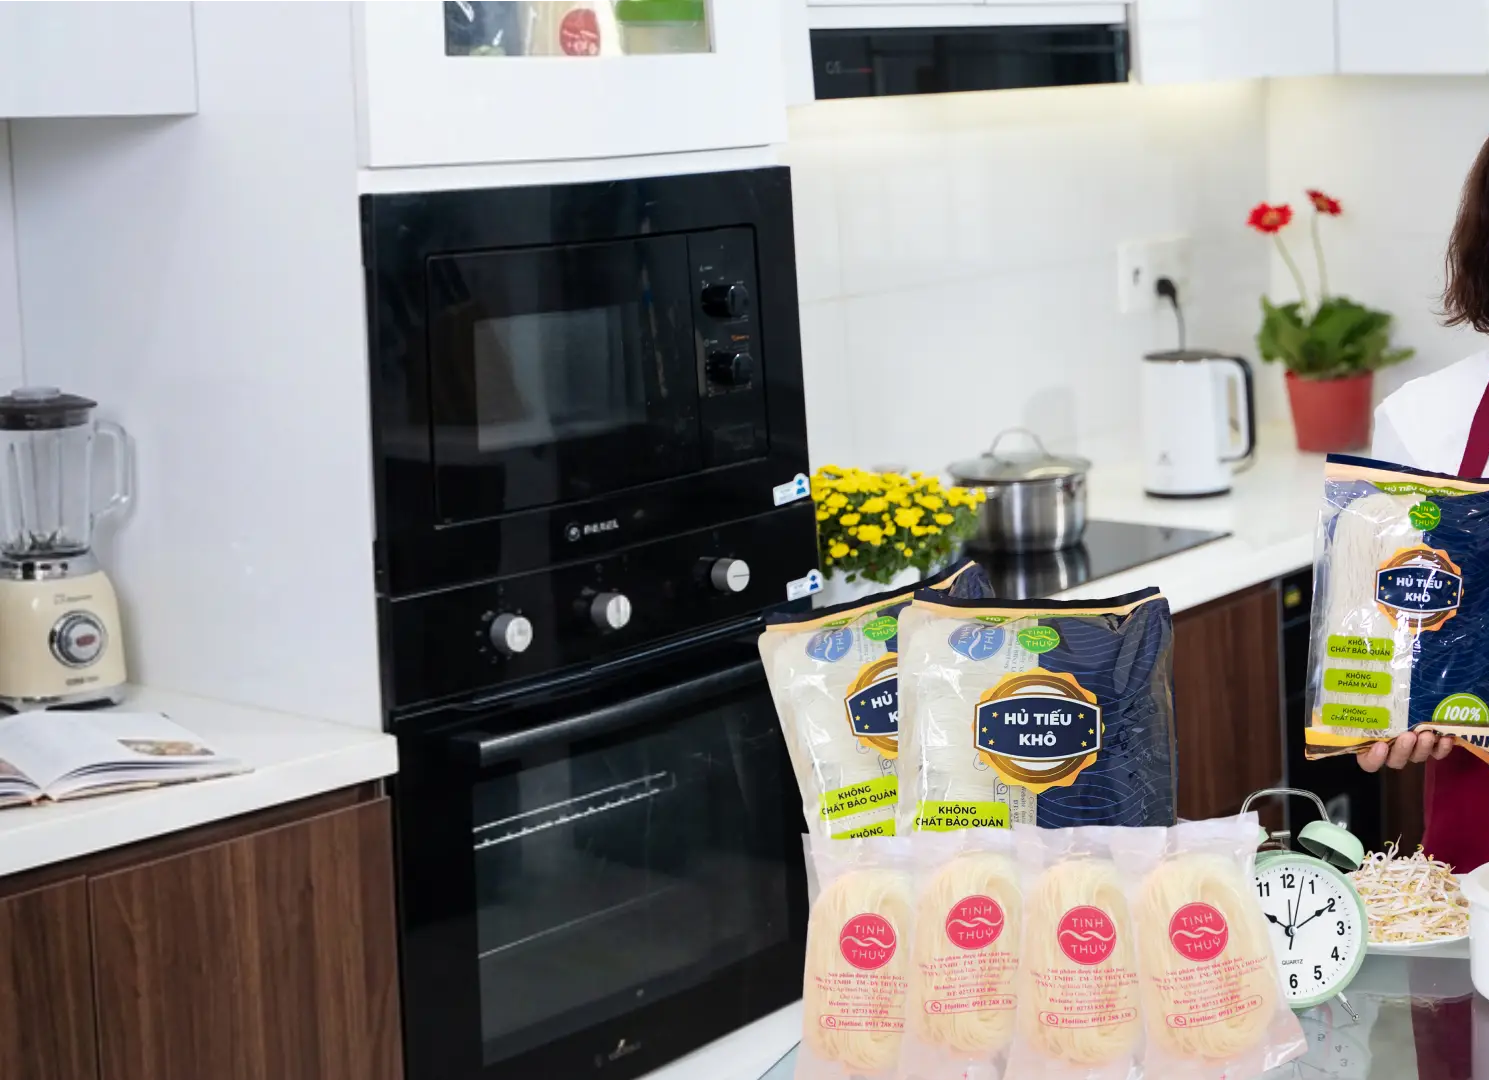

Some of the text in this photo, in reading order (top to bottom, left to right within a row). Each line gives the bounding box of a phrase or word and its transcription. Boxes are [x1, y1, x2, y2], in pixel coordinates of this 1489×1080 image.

[1396, 574, 1443, 589] HỦ TIẾU
[1404, 589, 1430, 602] KHÔ
[1346, 672, 1371, 680] KHÔNG
[870, 690, 893, 709] HỦ
[1004, 708, 1072, 726] HỦ TIẾU
[1444, 705, 1481, 722] 100%
[1019, 731, 1057, 746] KHÔ
[838, 785, 872, 800] KHÔNG
[821, 789, 897, 816] CHẤT BẢO QUẢN
[938, 804, 977, 815] KHÔNG
[916, 815, 943, 826] CHẤT
[945, 816, 969, 827] BẢO
[971, 816, 1004, 828] QUẢN
[1280, 873, 1295, 888] 12
[1309, 879, 1315, 894] 1
[1256, 882, 1270, 897] 11
[1327, 898, 1336, 912] 2
[1336, 921, 1345, 936] 3
[1331, 946, 1339, 961] 4
[1314, 965, 1323, 980] 5
[1289, 973, 1298, 989] 6
